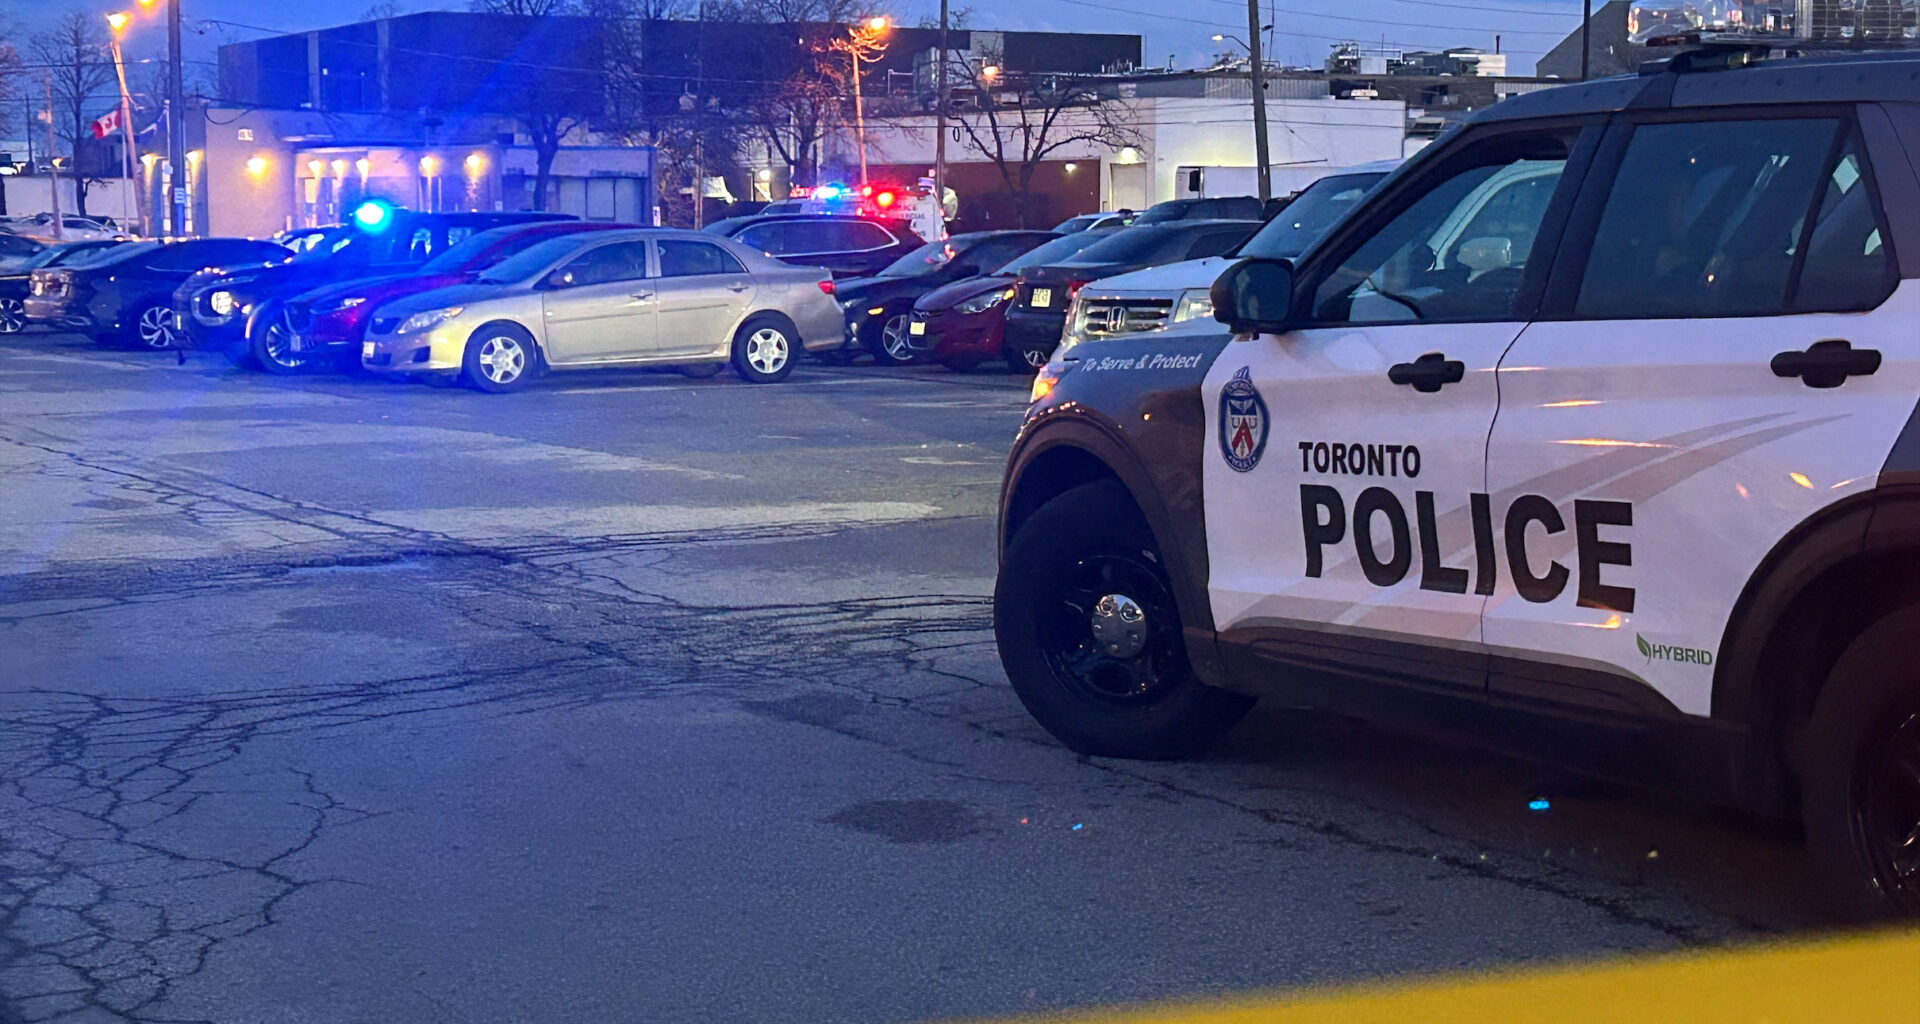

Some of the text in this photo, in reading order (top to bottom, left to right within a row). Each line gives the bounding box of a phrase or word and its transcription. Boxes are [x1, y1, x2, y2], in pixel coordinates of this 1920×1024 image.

[1081, 352, 1203, 372] To Serve & Protect
[1299, 442, 1421, 478] TORONTO
[1300, 484, 1636, 613] POLICE
[1652, 643, 1713, 666] HYBRID
